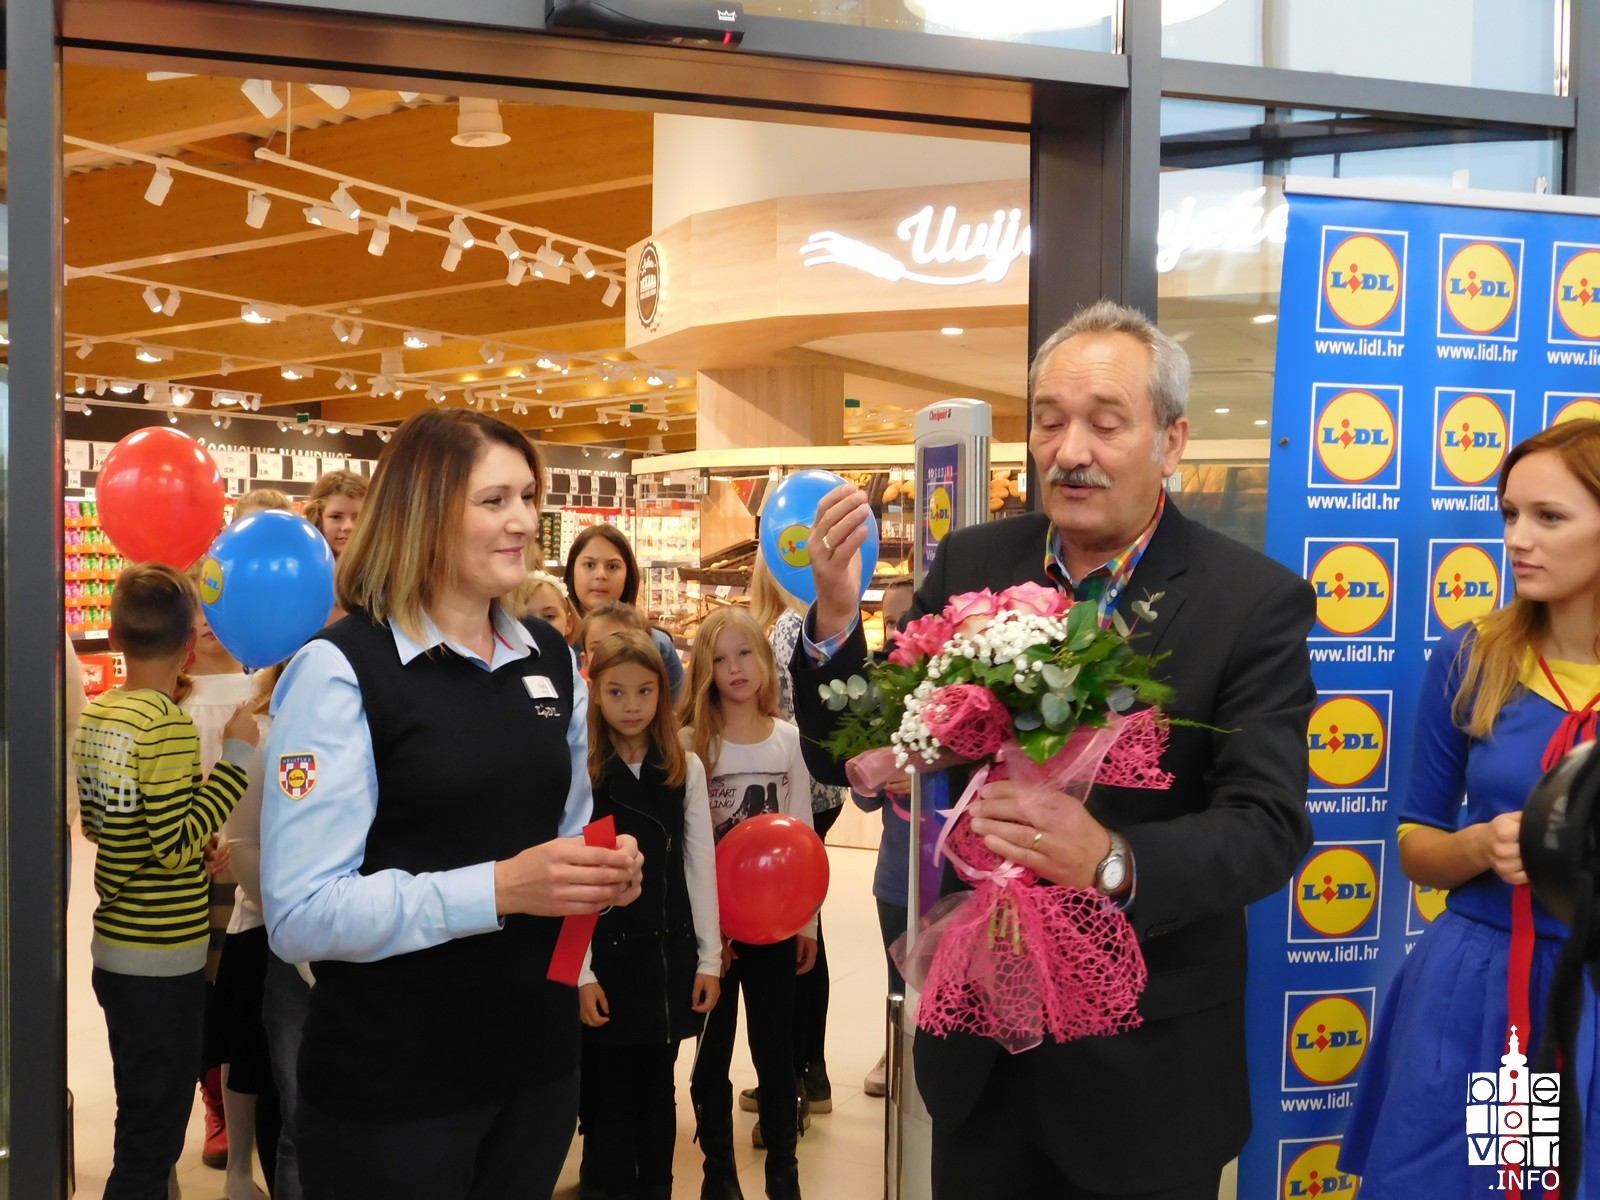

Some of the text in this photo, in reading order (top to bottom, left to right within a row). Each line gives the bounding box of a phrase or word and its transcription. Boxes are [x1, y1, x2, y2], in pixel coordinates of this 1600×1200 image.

[1331, 263, 1394, 294] LIDL
[1450, 270, 1510, 300] LIDL
[1562, 278, 1600, 308] LID
[1315, 339, 1404, 358] www.lidl.hr
[1437, 344, 1518, 362] www.lidl.hr
[1322, 419, 1388, 449] LIDL
[1444, 422, 1501, 452] LIDL
[1307, 492, 1400, 511] www.lidl.hr
[781, 540, 809, 557] LID
[1316, 572, 1384, 602] LIDL
[1437, 572, 1493, 602] LIDL
[1309, 724, 1378, 754] LIDL
[708, 788, 737, 798] START
[1305, 796, 1387, 813] ww.lidl.hr
[1302, 875, 1371, 904] LIDL
[1287, 946, 1379, 963] www.lidl.hr
[1296, 1024, 1362, 1053] LIDL
[1281, 1091, 1353, 1112] www.lidl.
[1290, 1170, 1353, 1198] LIDL
